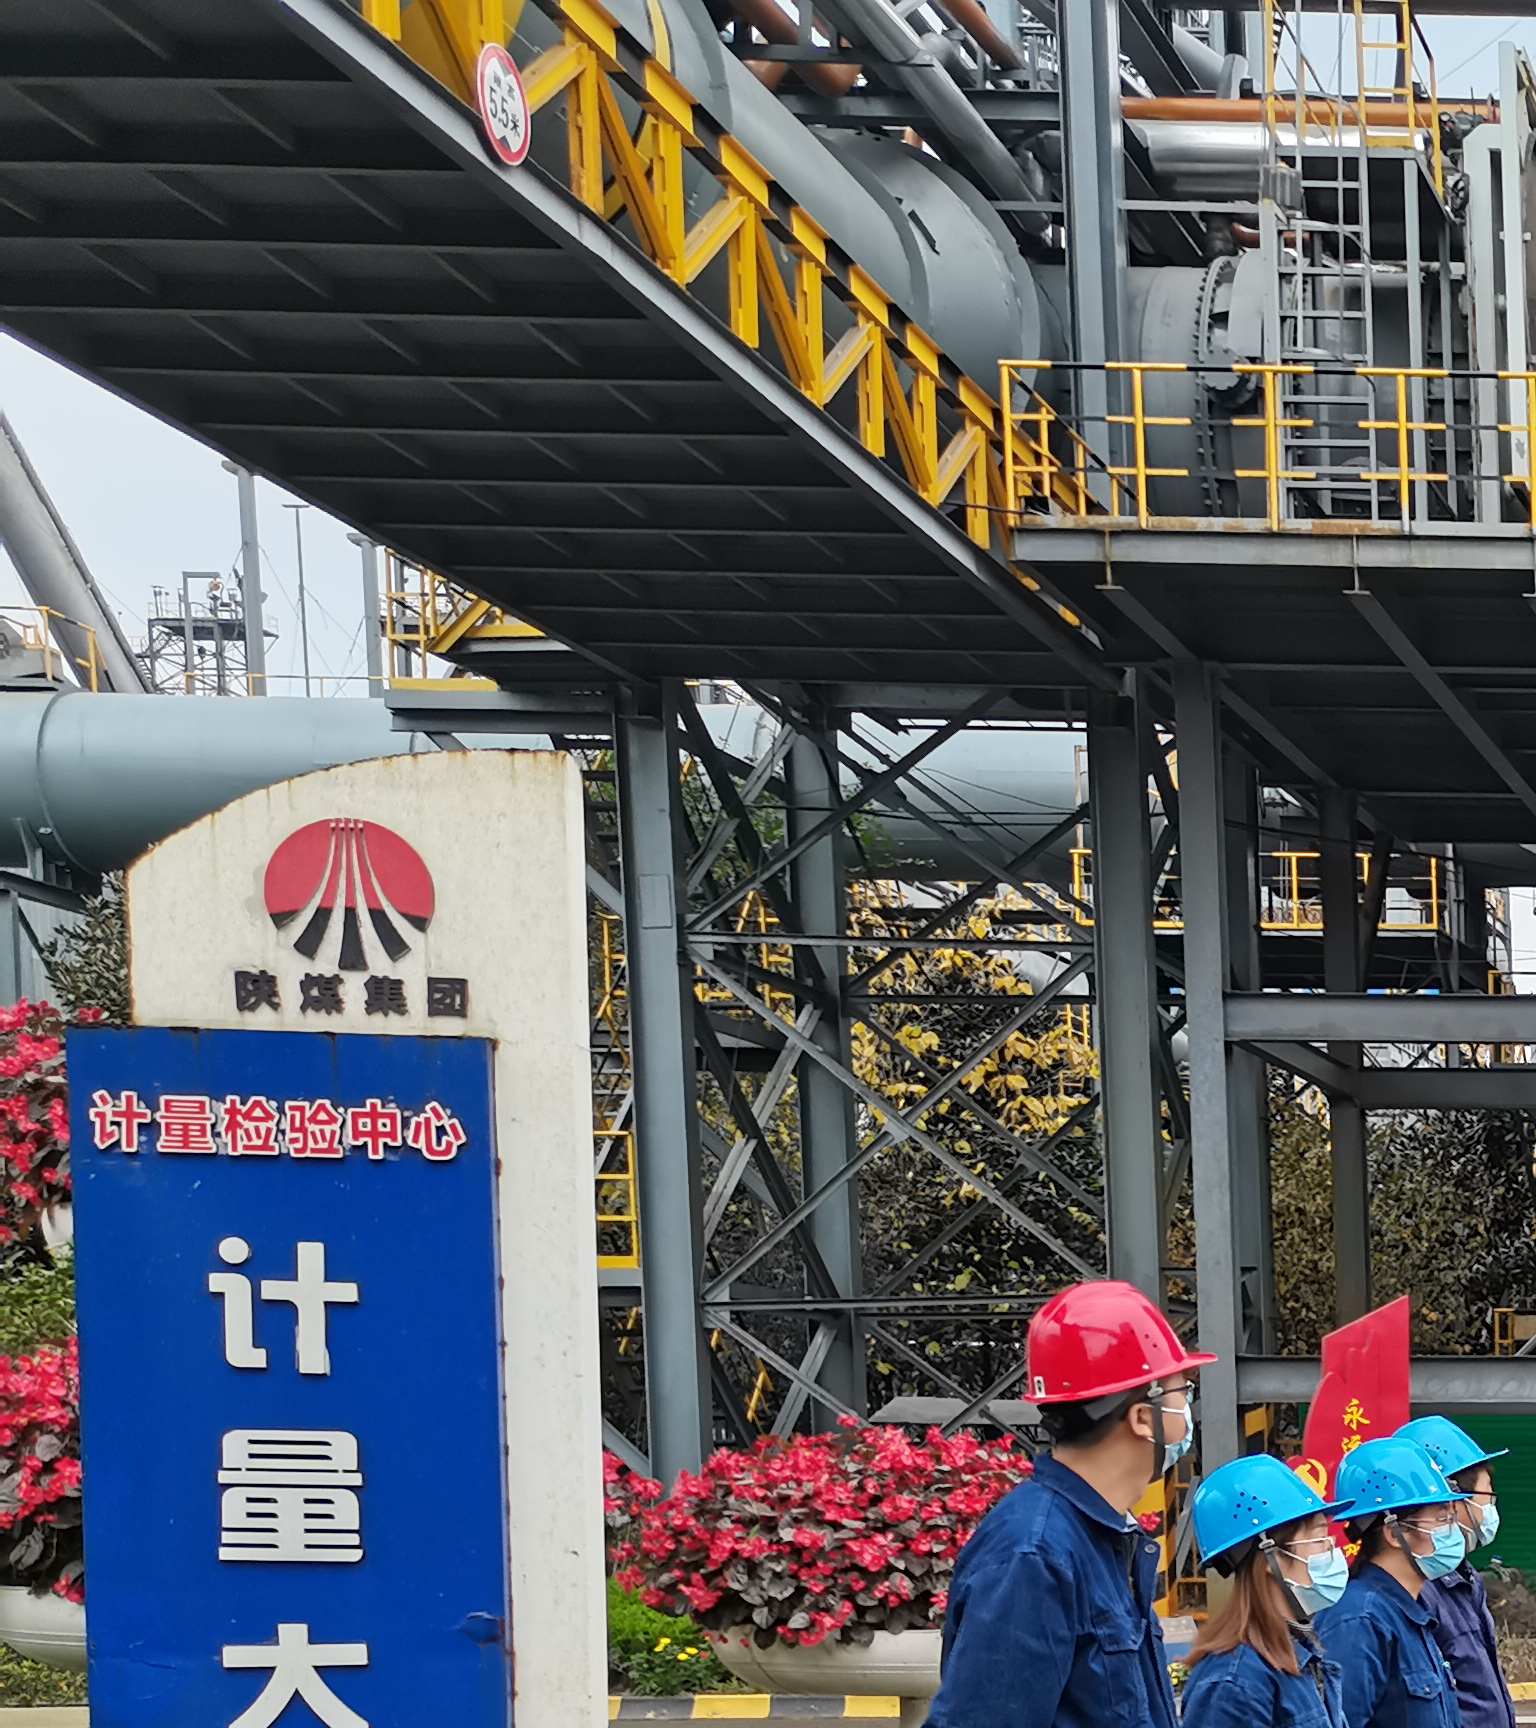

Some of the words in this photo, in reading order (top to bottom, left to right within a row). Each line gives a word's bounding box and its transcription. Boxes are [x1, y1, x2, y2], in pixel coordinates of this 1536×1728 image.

[489, 86, 521, 139] 5.5米
[234, 969, 470, 1019] 陕煤集团
[88, 1089, 467, 1162] 计量检验中心
